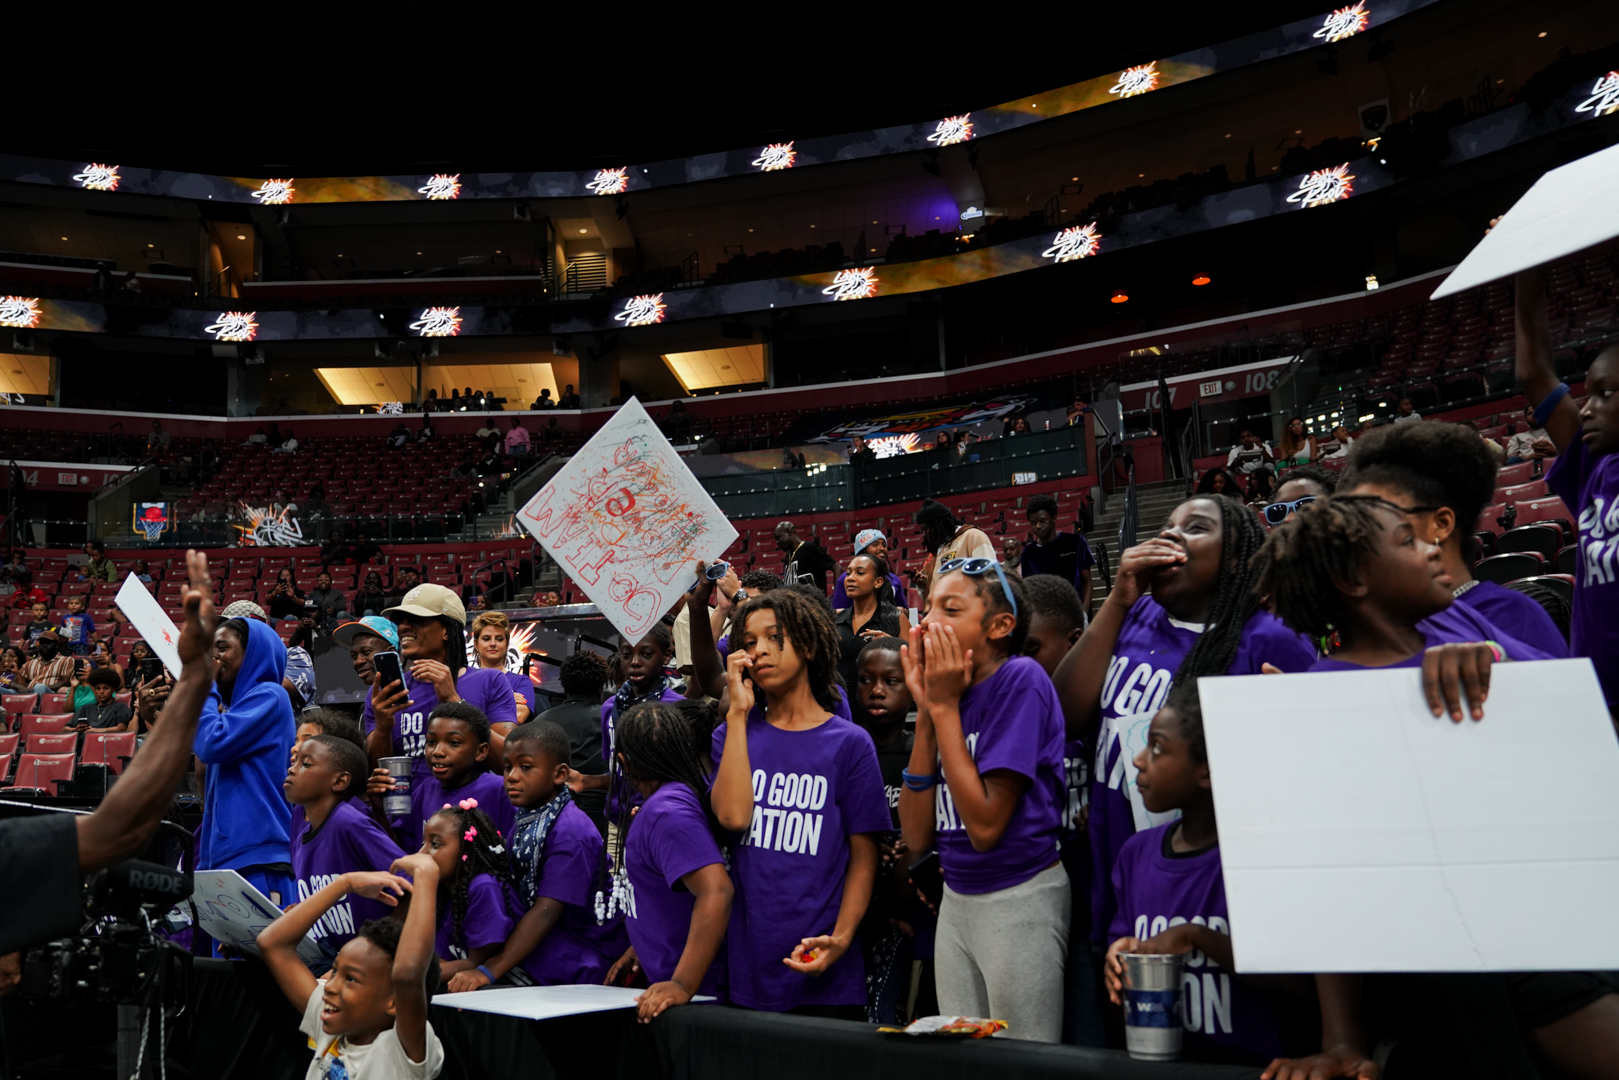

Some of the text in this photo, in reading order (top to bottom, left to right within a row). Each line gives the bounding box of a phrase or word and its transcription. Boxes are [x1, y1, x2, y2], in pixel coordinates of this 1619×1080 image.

[1204, 383, 1218, 395] EXIT
[1245, 370, 1279, 394] 108
[61, 474, 74, 484] EXIT
[524, 484, 615, 587] TEAM
[401, 711, 423, 735] DO
[767, 772, 828, 811] GOOD
[741, 805, 823, 856] ATION
